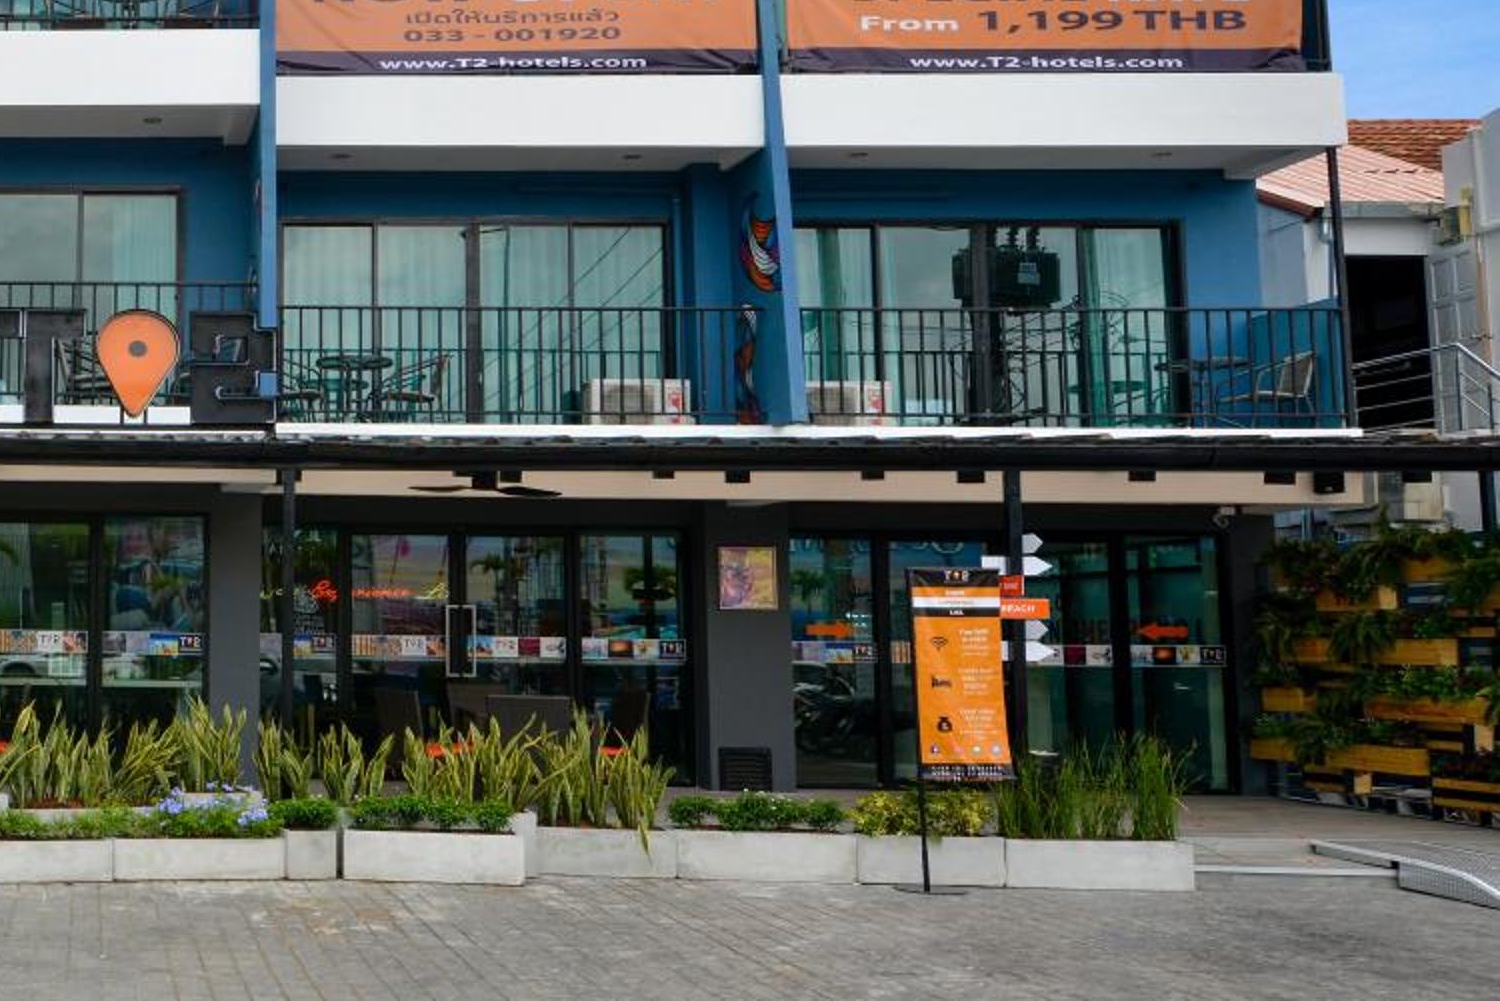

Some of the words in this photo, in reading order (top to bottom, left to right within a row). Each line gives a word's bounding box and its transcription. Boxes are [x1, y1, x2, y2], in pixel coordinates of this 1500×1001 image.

[860, 15, 960, 32] From
[978, 10, 1123, 34] 1,199
[1132, 9, 1247, 31] THB
[403, 28, 464, 42] 033
[493, 26, 621, 41] 001920
[379, 54, 647, 71] www.T2-hotels.com
[909, 55, 1183, 70] www.T2-hotels.com
